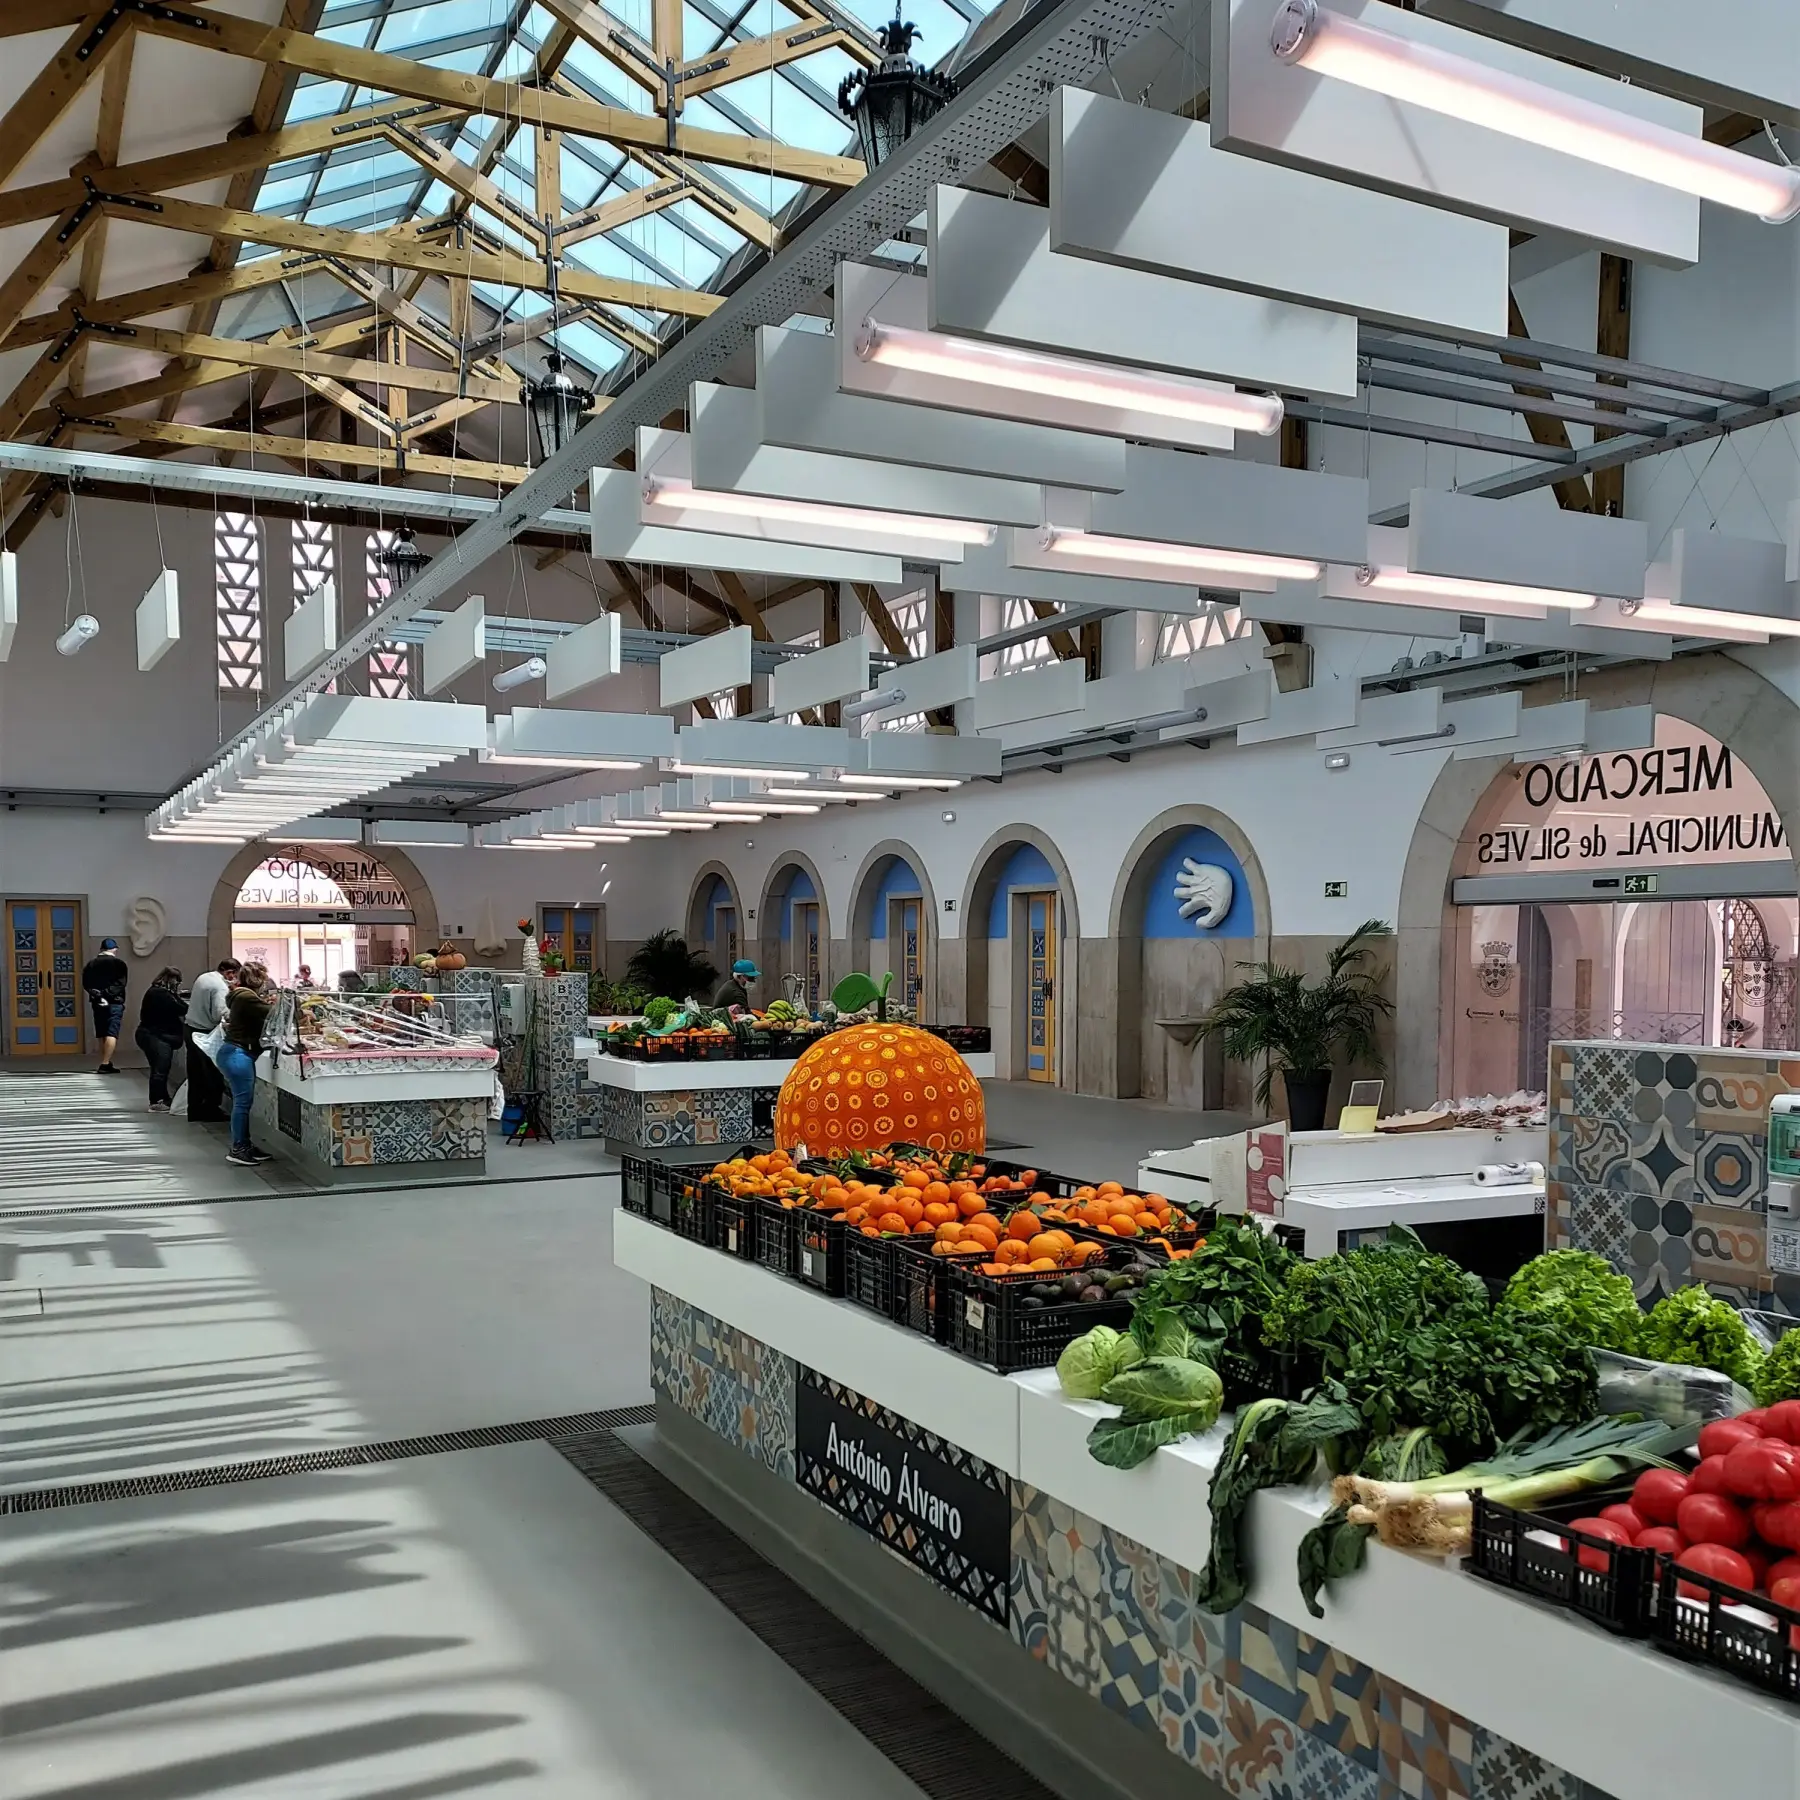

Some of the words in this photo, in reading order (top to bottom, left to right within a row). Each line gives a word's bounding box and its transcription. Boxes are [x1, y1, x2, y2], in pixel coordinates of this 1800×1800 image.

[558, 984, 566, 994] B
[826, 1422, 891, 1496] António
[897, 1452, 962, 1540] Álvaro
